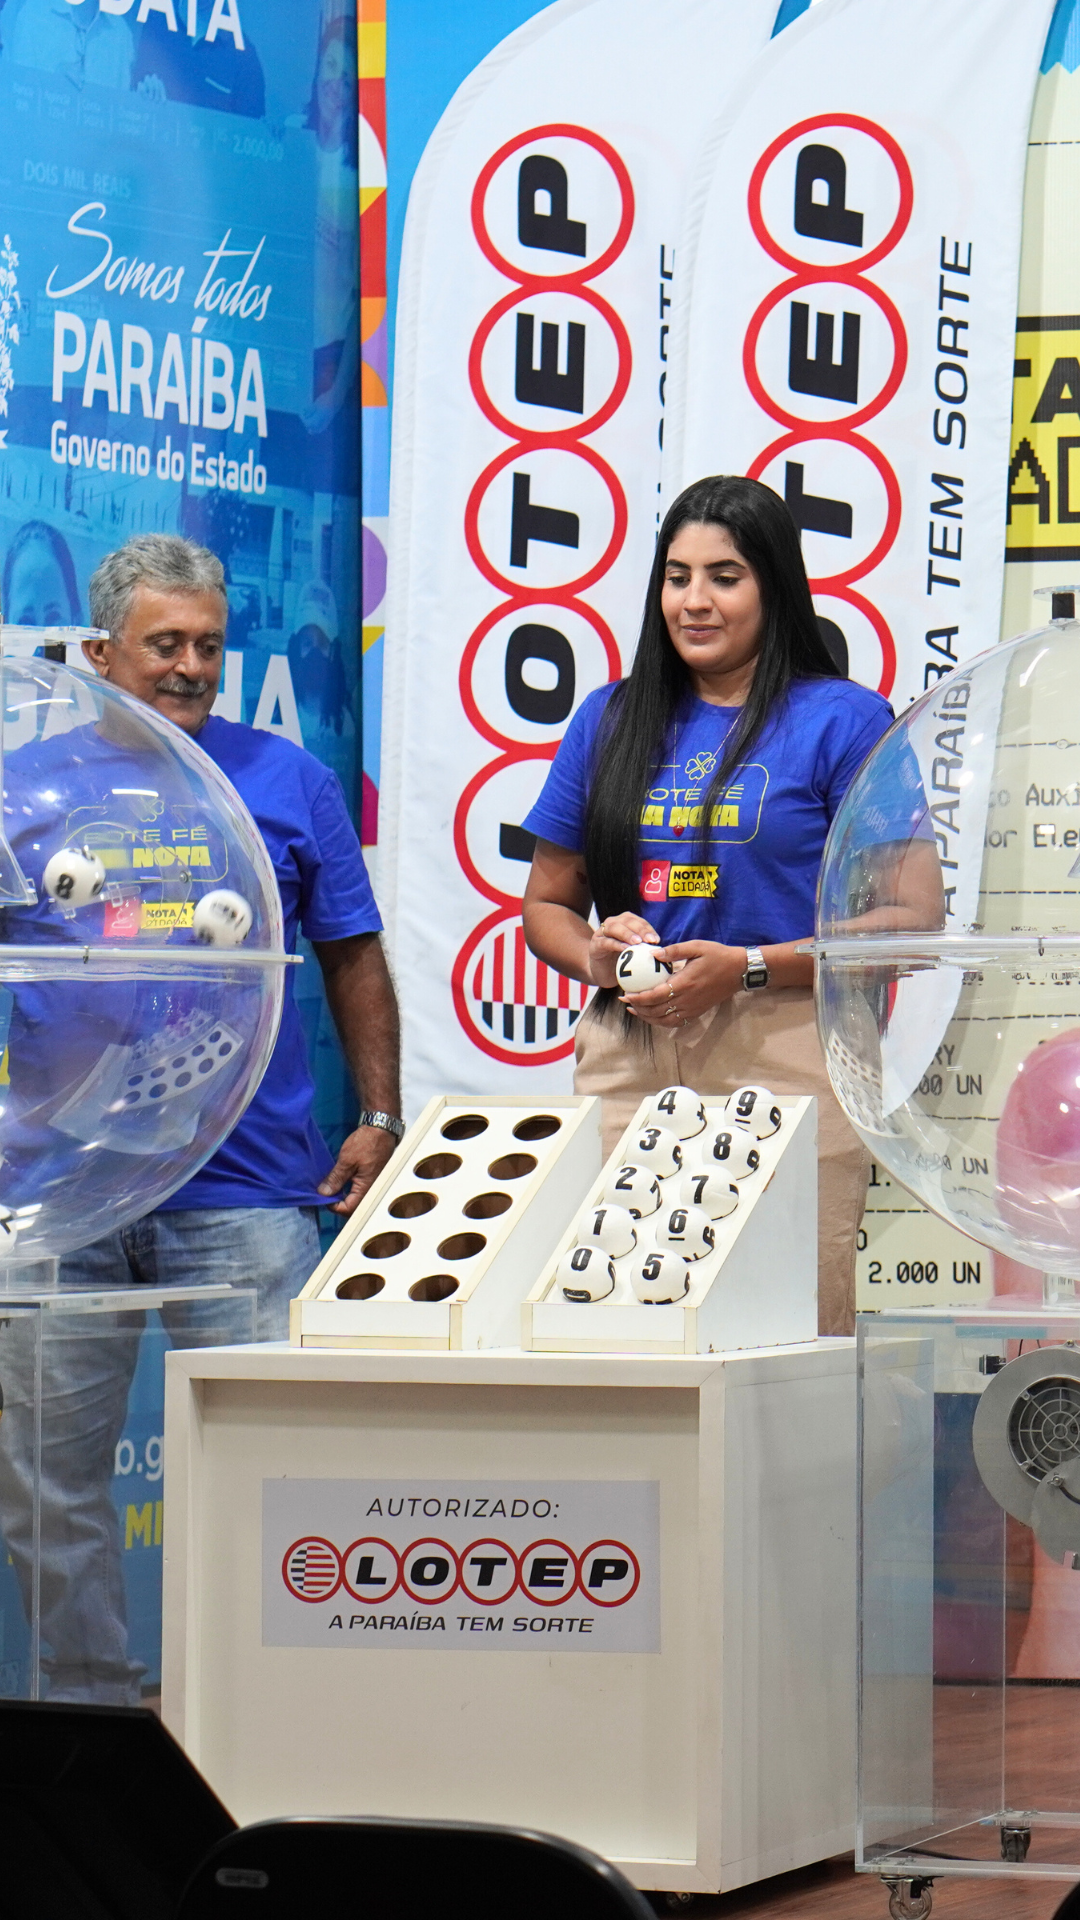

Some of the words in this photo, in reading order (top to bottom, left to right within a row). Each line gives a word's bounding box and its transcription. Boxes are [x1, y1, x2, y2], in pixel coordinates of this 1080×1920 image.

[24, 159, 58, 186] DOIS
[64, 166, 86, 190] MIL
[93, 173, 131, 198] REAIS
[46, 202, 186, 303] Somos
[194, 228, 272, 321] todos
[932, 236, 972, 450] SORTE
[52, 311, 268, 438] PARAÍBA
[51, 420, 150, 476] Governo
[156, 436, 184, 482] do
[190, 443, 267, 495] Estado
[927, 472, 964, 596] TEM
[645, 788, 702, 801] OTE
[172, 825, 207, 841] FÉ
[1033, 823, 1080, 848] Ele
[133, 846, 211, 868] NOTA
[673, 871, 705, 880] NOTA
[147, 909, 177, 918] NOTA
[619, 949, 634, 978] 2
[956, 1074, 982, 1095] UN
[657, 1090, 677, 1115] 4
[736, 1090, 758, 1117] 9
[639, 1128, 661, 1151] 3
[713, 1132, 732, 1161] 8
[615, 1166, 637, 1190] 2
[962, 1156, 989, 1175] UN
[691, 1175, 709, 1204] 7
[593, 1209, 607, 1235] 1
[668, 1209, 688, 1234] 6
[571, 1248, 593, 1271] 0
[642, 1253, 664, 1281] 5
[868, 1261, 938, 1284] 2.000
[952, 1261, 981, 1284] UN
[366, 1498, 560, 1519] AUTORIZADO:
[355, 1556, 629, 1588] LOTEP
[329, 1614, 344, 1629] A
[349, 1611, 446, 1631] PARAÍBA
[457, 1616, 504, 1632] TEM
[512, 1617, 595, 1633] SORTE
